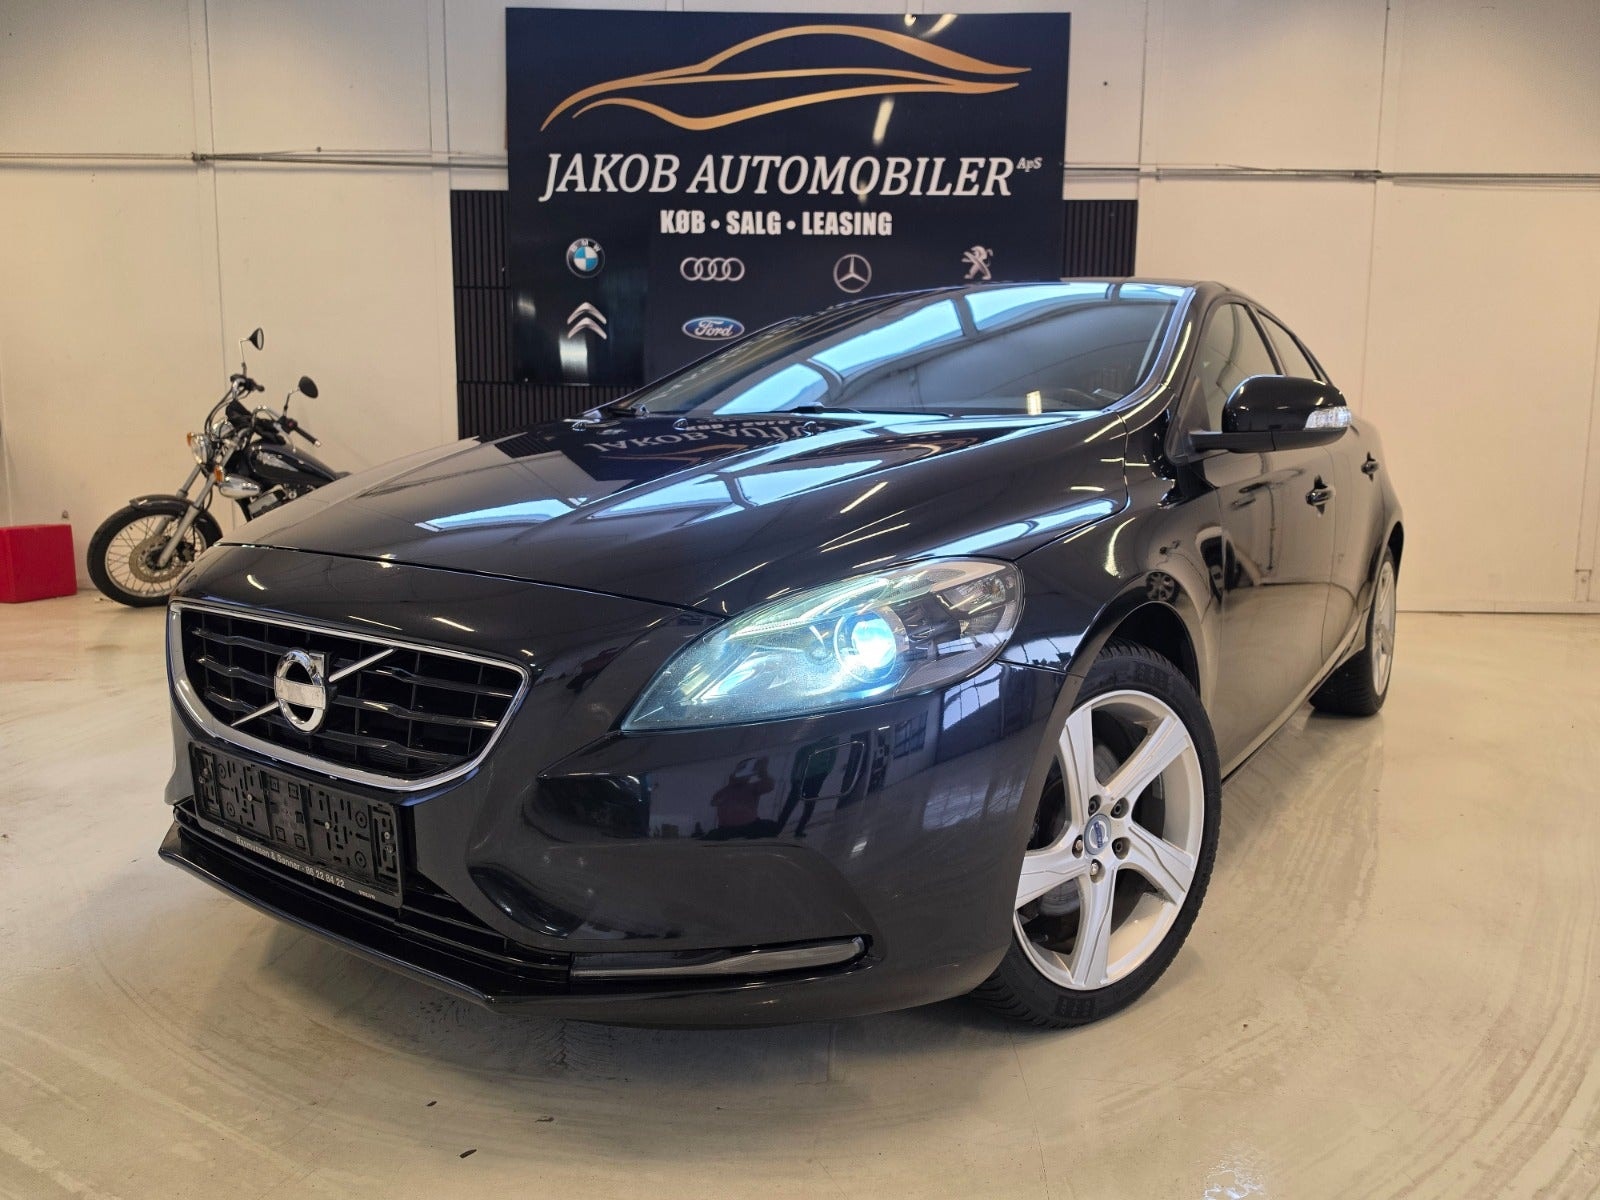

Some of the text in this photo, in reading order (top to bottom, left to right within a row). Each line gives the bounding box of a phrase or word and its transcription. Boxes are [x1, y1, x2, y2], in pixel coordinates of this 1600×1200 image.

[538, 153, 1043, 202] JAKOB AUTOMOBILER ApS
[659, 210, 893, 237] KØB SALG LEASING
[694, 320, 735, 337] Ford
[315, 869, 325, 881] 22
[335, 877, 346, 889] 22
